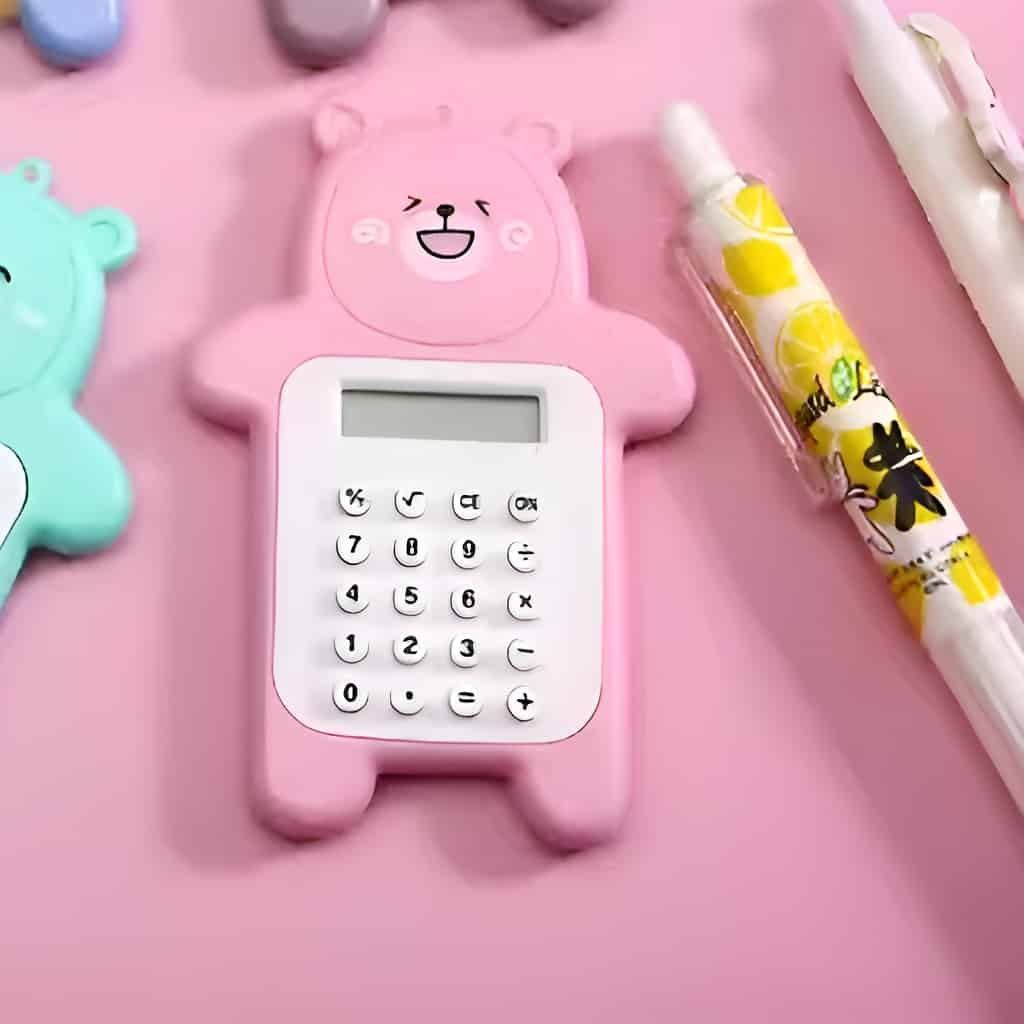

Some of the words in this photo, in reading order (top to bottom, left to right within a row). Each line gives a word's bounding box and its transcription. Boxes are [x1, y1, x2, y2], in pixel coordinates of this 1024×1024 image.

[348, 534, 362, 554] 7
[462, 539, 477, 559] 9
[345, 583, 359, 603] 4
[404, 585, 419, 605] 5
[461, 588, 476, 609] 6
[402, 635, 419, 655] 2
[459, 638, 475, 658] 3
[343, 682, 359, 703] 0
